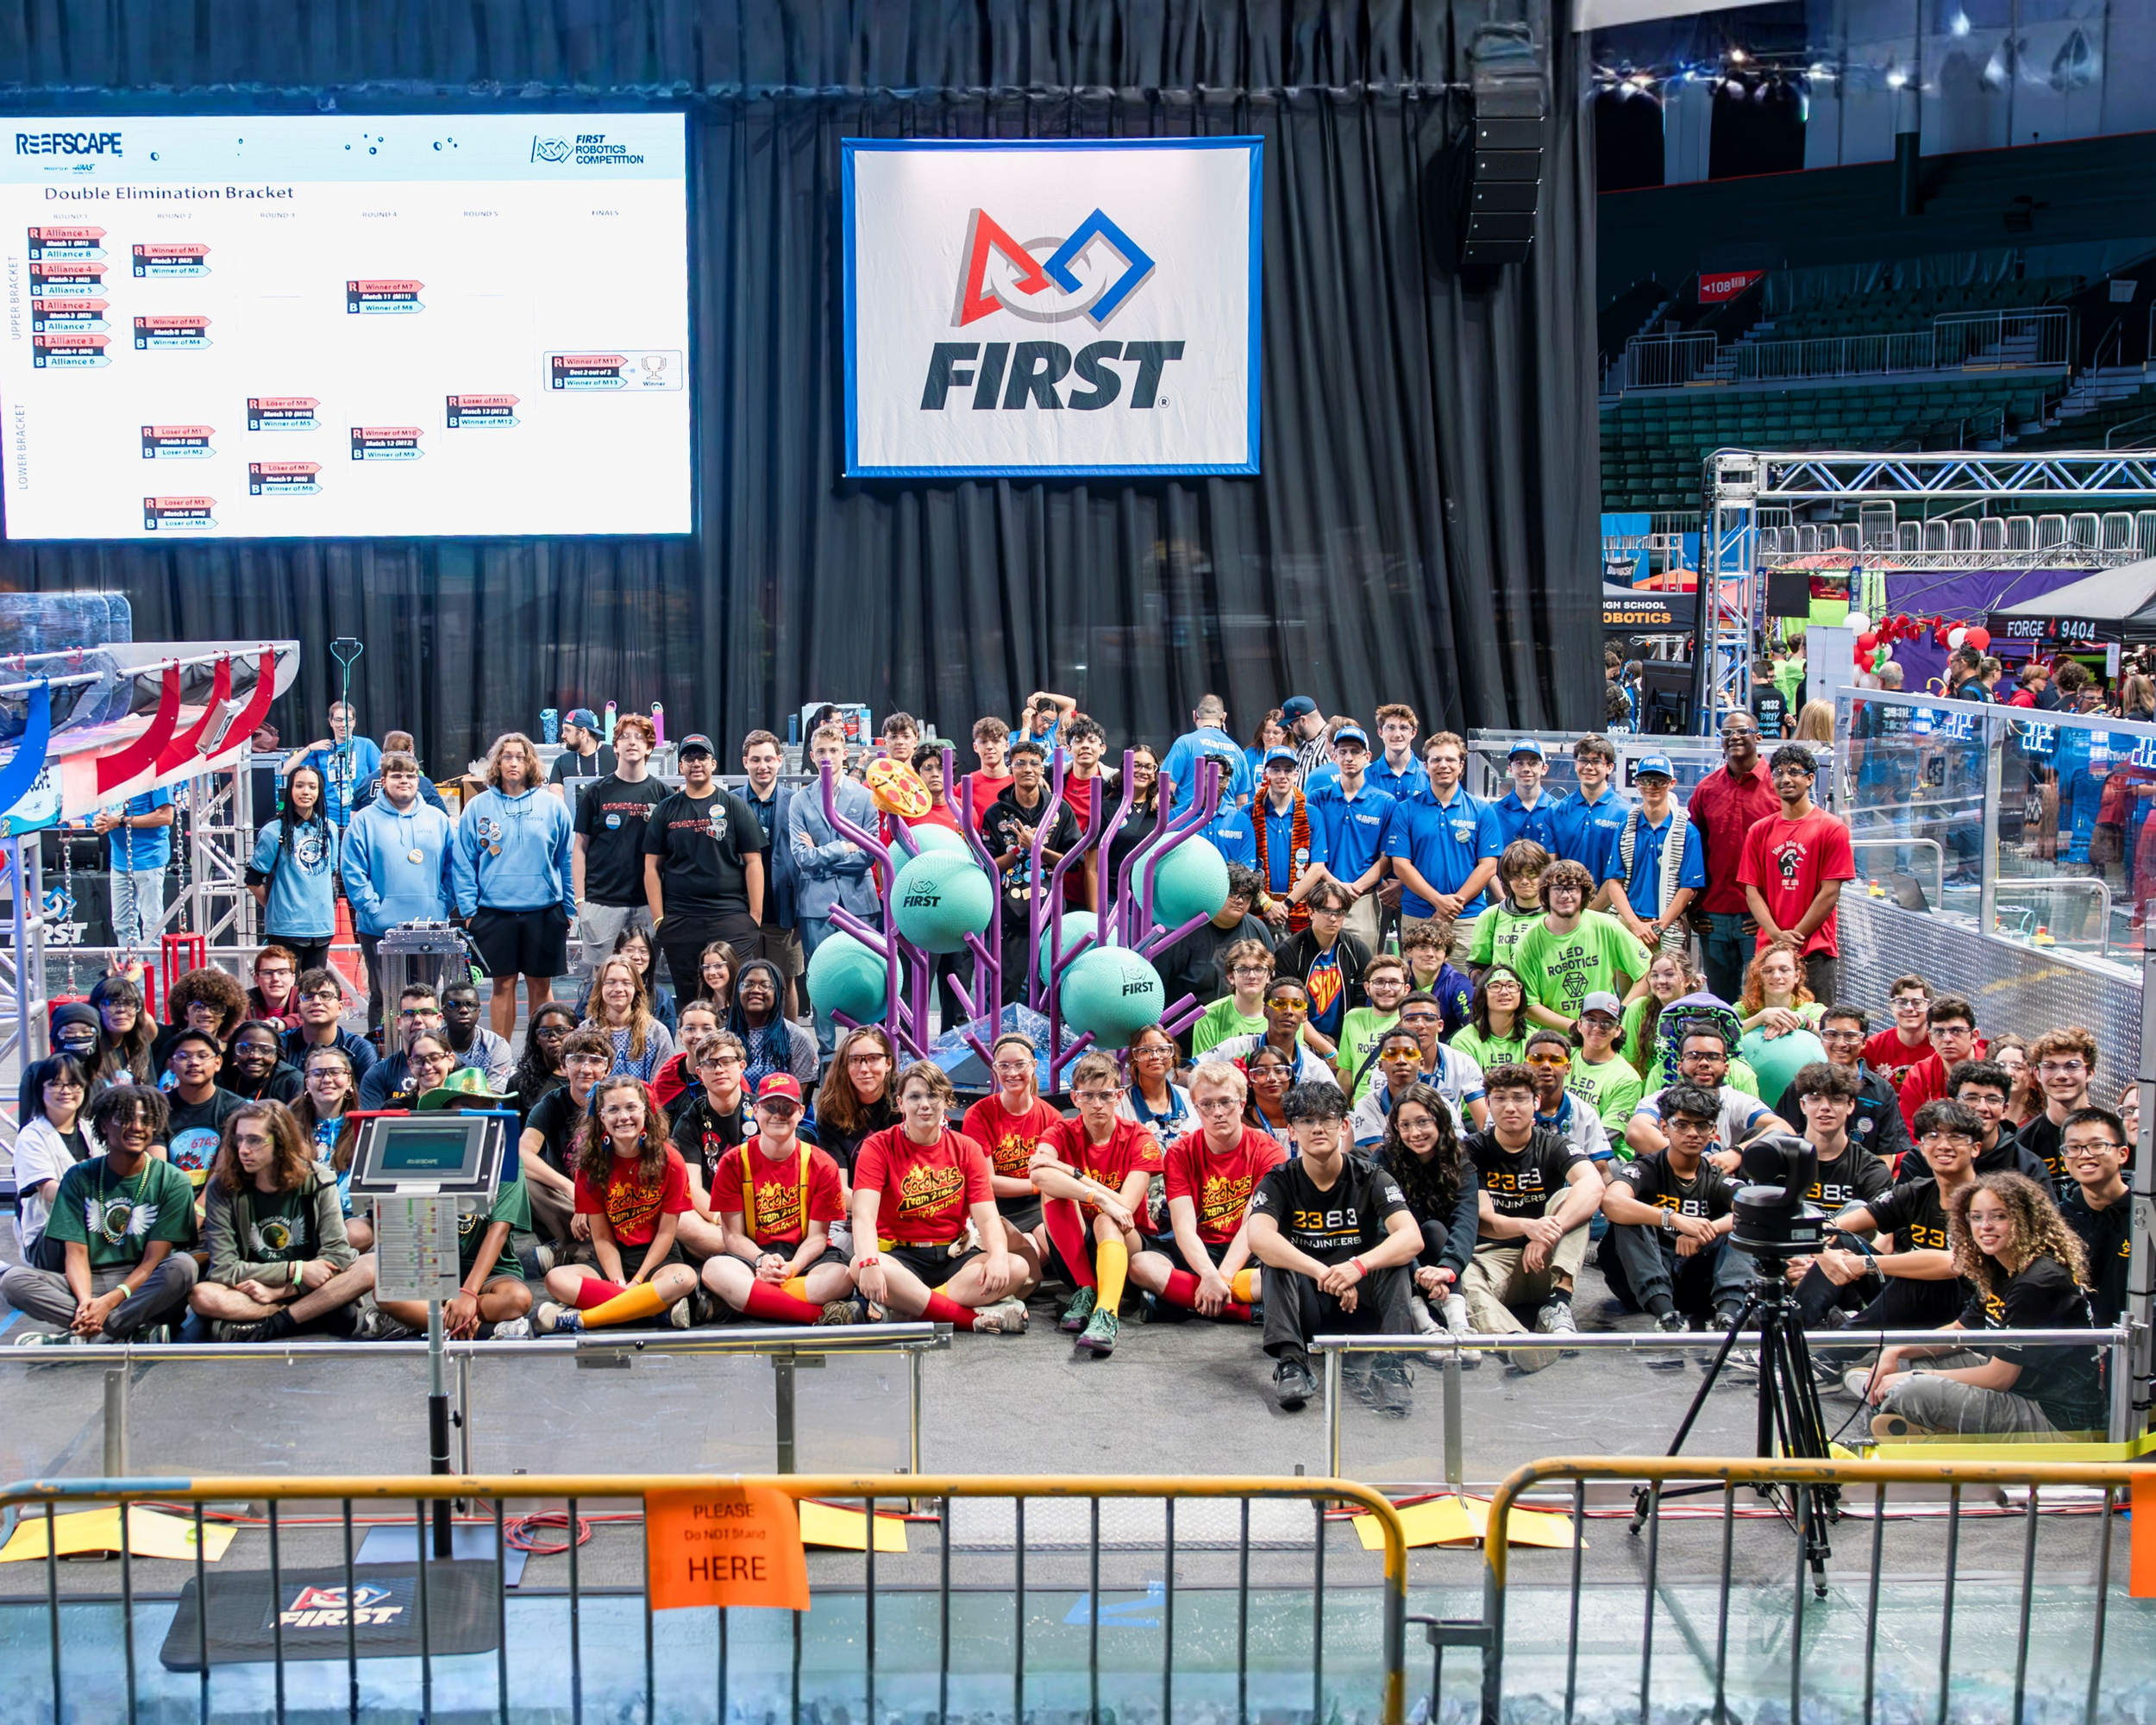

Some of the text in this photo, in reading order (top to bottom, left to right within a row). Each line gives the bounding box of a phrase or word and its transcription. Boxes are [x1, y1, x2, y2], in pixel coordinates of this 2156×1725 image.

[16, 132, 122, 154] REEFSCAPE
[576, 135, 605, 144] FIRST
[575, 144, 626, 154] ROBOTICS
[576, 154, 644, 165] COMPETITION
[45, 185, 294, 200] Double Elimination Bracket
[29, 229, 40, 238] R
[31, 250, 40, 259] B
[133, 246, 143, 255] R
[31, 264, 41, 274] R
[135, 267, 143, 276] B
[33, 285, 41, 293] B
[348, 282, 357, 292] R
[1711, 281, 1731, 293] 108
[8, 256, 21, 340] UPPER BRACKET
[34, 301, 43, 310] R
[350, 303, 358, 312] B
[34, 322, 43, 330] B
[34, 337, 44, 347] R
[36, 357, 45, 366] B
[554, 357, 563, 367] R
[920, 341, 1186, 411] FIRST
[555, 378, 563, 388] B
[248, 398, 258, 409] R
[448, 397, 457, 405] R
[250, 420, 259, 430] B
[449, 417, 457, 427] B
[143, 428, 152, 437] R
[354, 430, 362, 438] R
[15, 404, 28, 489] LOWER BRACKET
[145, 448, 154, 457] B
[354, 450, 362, 459] B
[1602, 601, 1666, 610] IGH SCHOOL
[1603, 612, 1672, 624] OBOTICS
[2007, 620, 2096, 640] FORGE 9404
[1761, 699, 1780, 710] 3932
[1199, 738, 1236, 752] VOLUNTEER
[903, 894, 941, 908] FIRST
[9, 922, 88, 945] RST
[1513, 924, 1531, 933] LE
[1557, 946, 1583, 960] LED
[1548, 955, 1599, 976] ROBOTICS
[1122, 981, 1154, 997] FIRST
[1561, 998, 1583, 1011] 672
[1490, 1053, 1513, 1064] LED
[1570, 1076, 1595, 1091] LED
[191, 1136, 219, 1150] 6743
[1806, 1182, 1853, 1201] 383
[906, 1192, 930, 1208] Team
[1294, 1208, 1358, 1229] 2383
[693, 1502, 755, 1520] PLEASE
[685, 1528, 766, 1540] Do NOT Stand
[688, 1556, 767, 1582] HERE
[268, 1606, 404, 1629] FIRST
